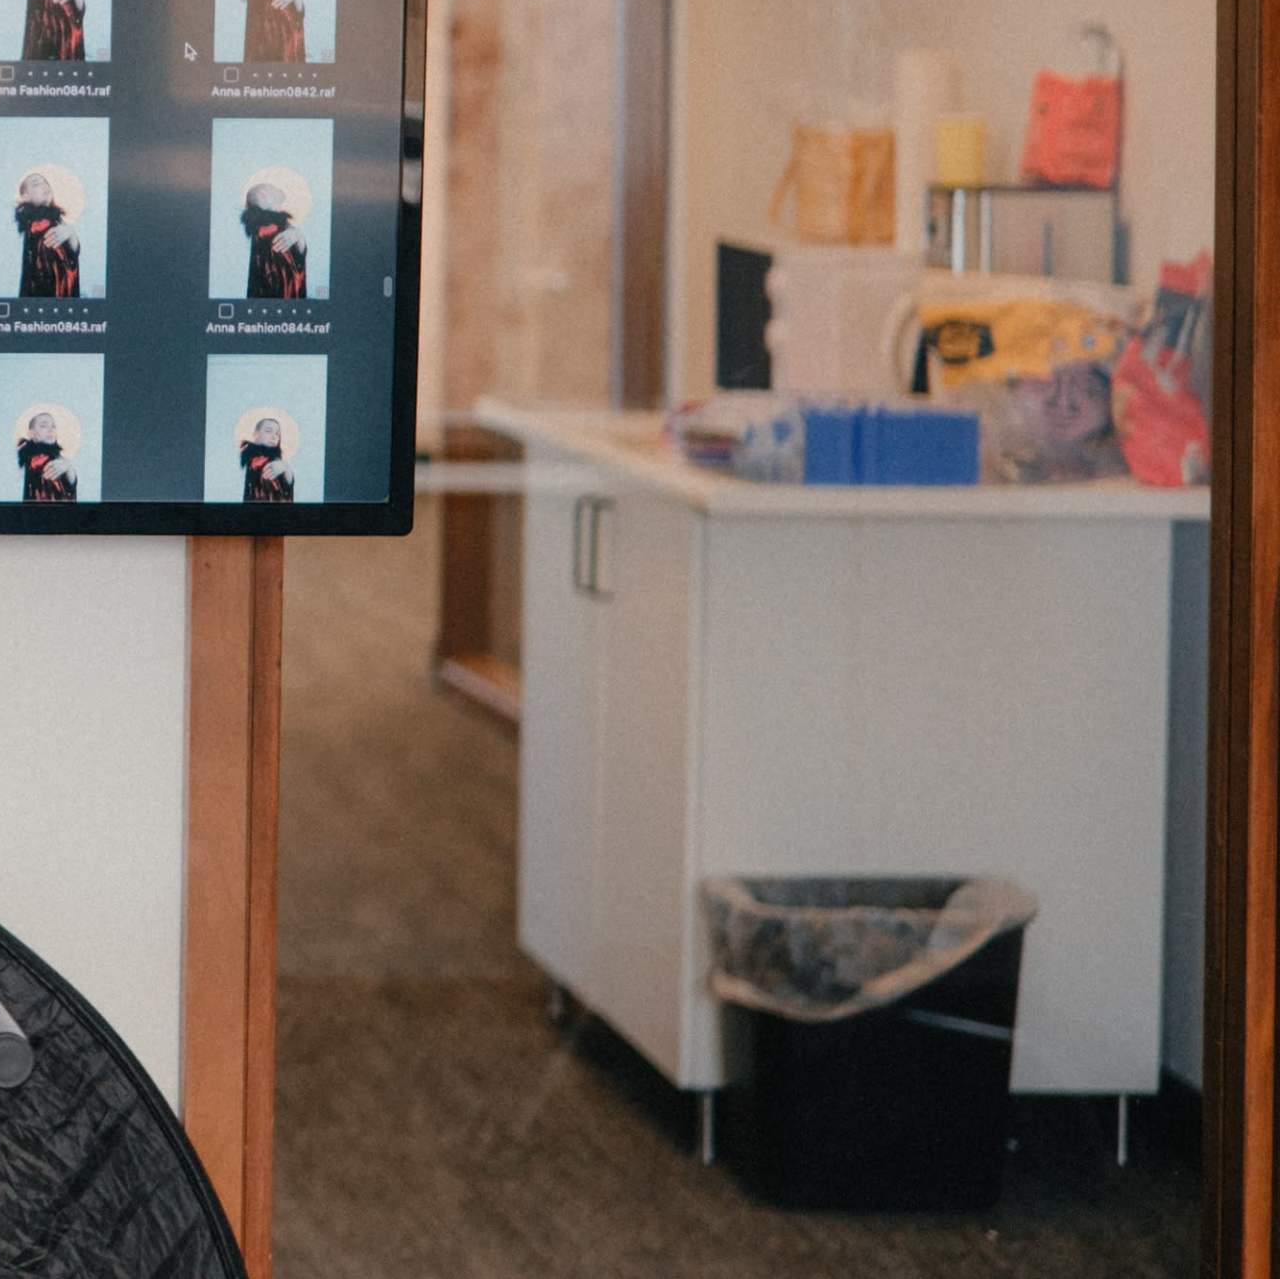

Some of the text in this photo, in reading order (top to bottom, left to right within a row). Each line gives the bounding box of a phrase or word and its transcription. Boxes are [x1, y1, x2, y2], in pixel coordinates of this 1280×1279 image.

[19, 84, 111, 98] Fashion0841.raf
[211, 85, 336, 99] Anna Fashion0842.raf
[13, 321, 107, 334] Fashion0843.raf
[205, 322, 330, 335] Anna Fashion0844.raf
